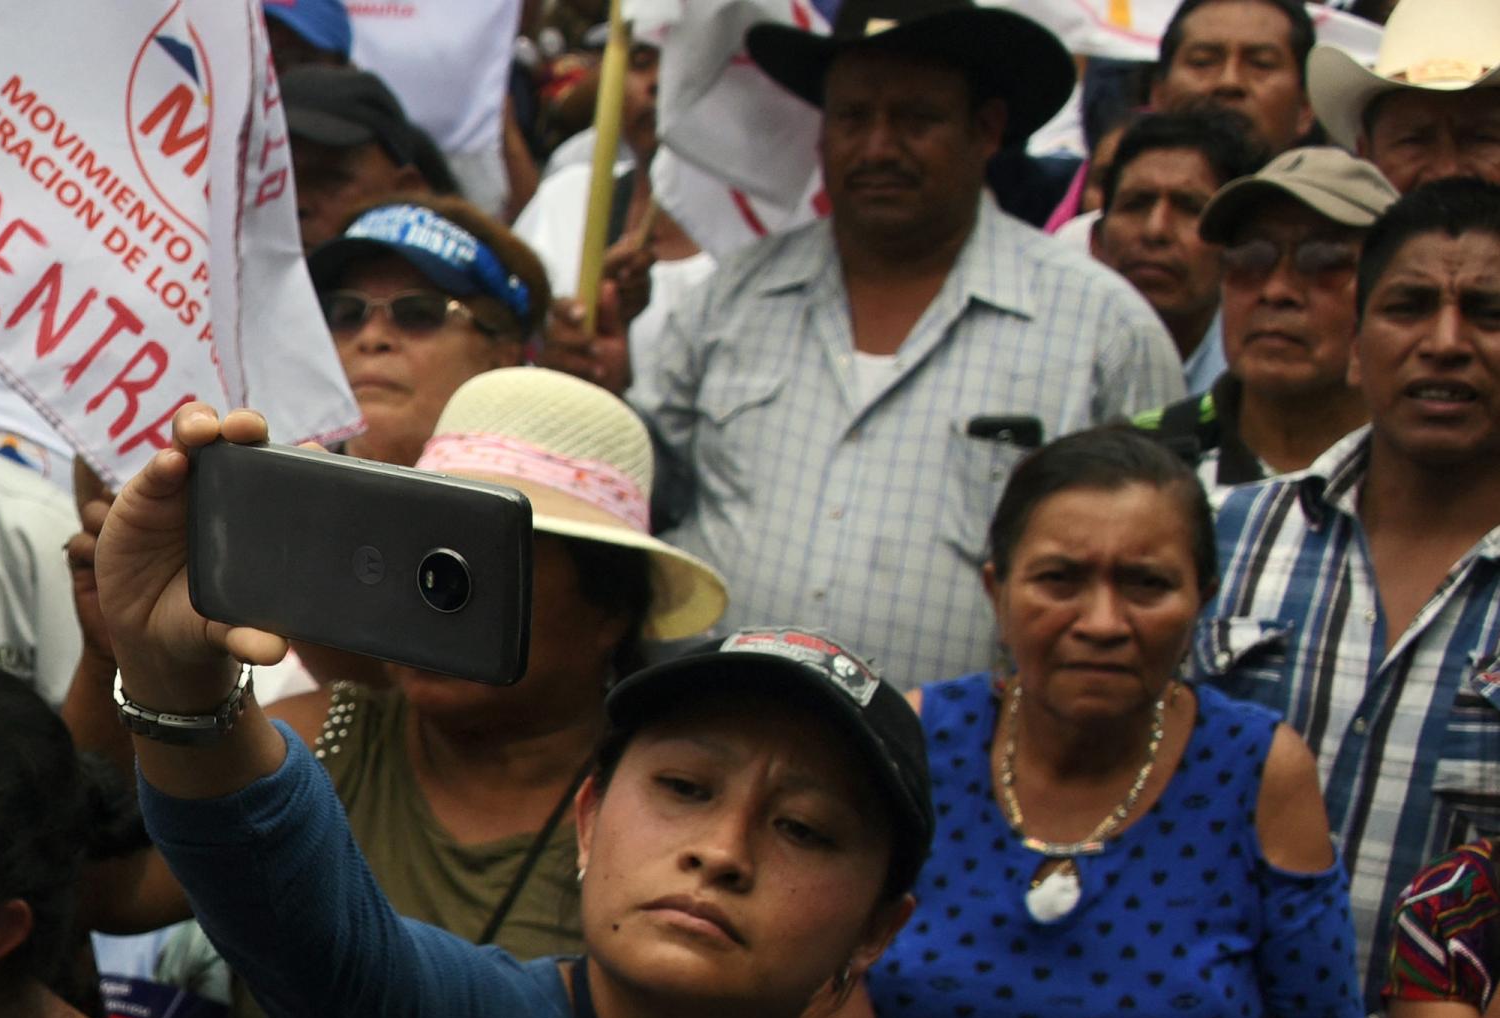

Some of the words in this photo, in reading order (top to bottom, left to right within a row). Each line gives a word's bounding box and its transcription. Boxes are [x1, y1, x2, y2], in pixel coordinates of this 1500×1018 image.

[0, 75, 192, 264] MOVIMIENTO
[138, 83, 211, 180] M
[103, 225, 148, 273] DE
[143, 259, 202, 327] LOS
